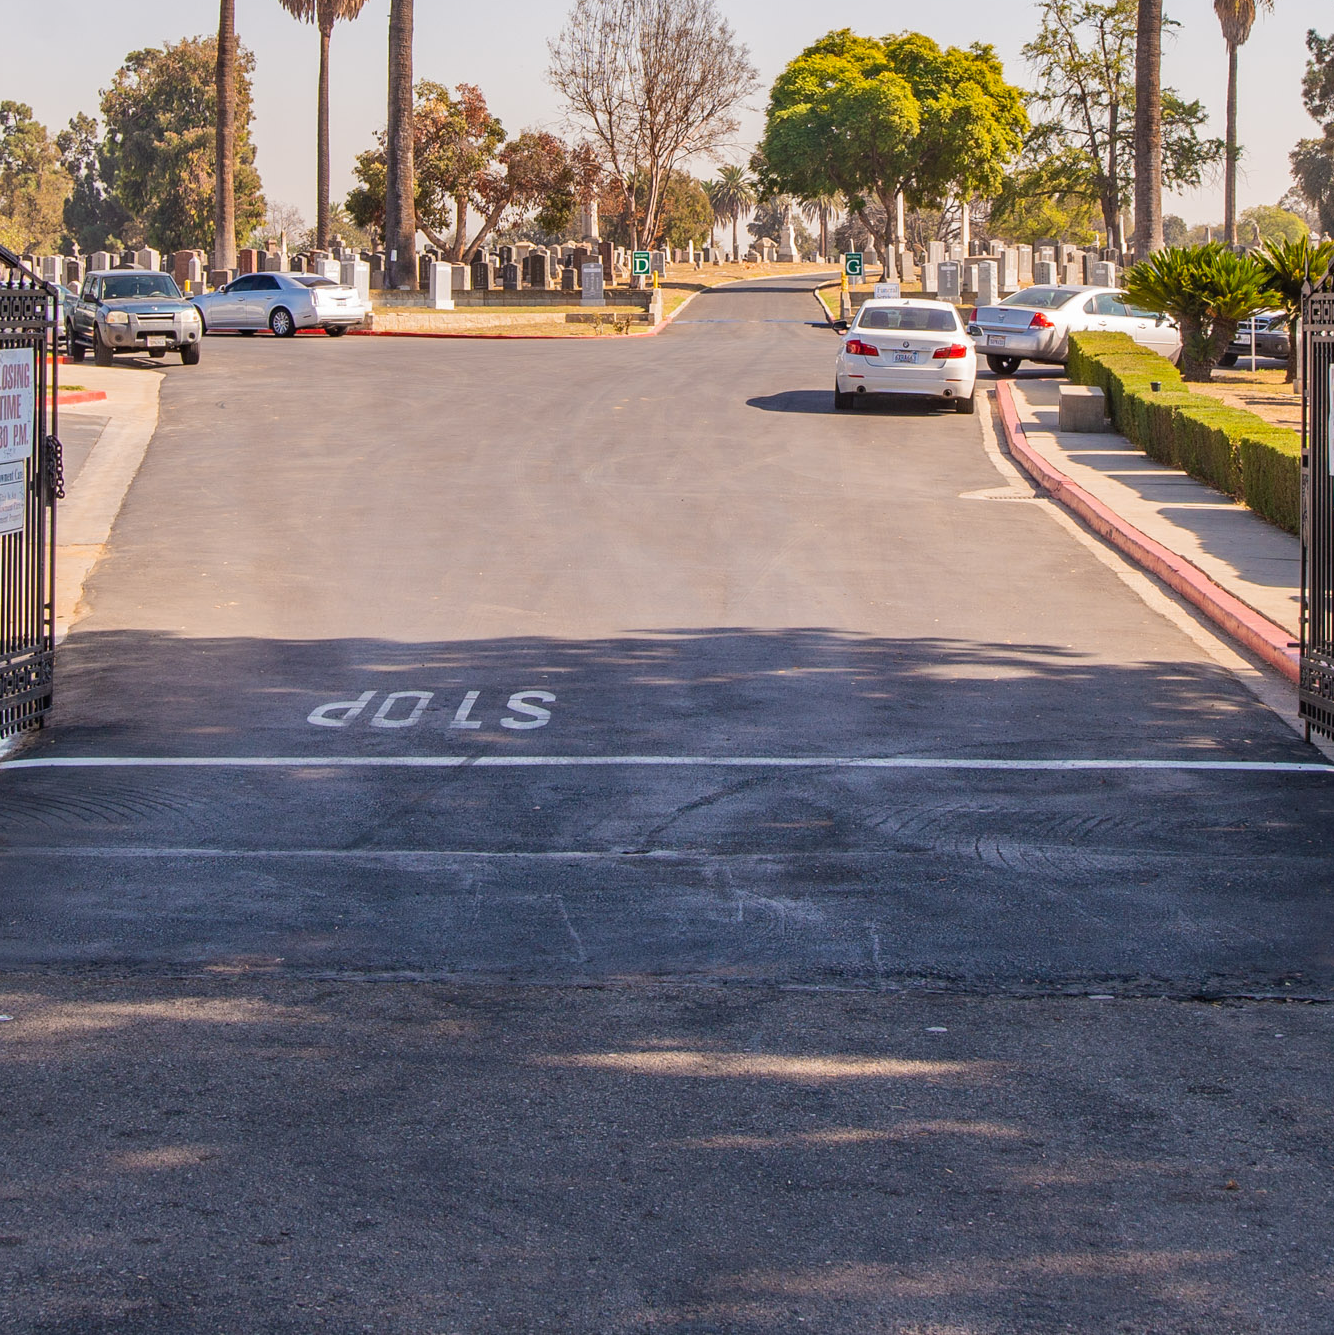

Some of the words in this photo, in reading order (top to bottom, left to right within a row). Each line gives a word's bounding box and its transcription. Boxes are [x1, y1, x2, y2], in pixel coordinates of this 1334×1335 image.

[635, 258, 649, 273] D
[846, 259, 861, 274] G
[0, 394, 22, 421] TIME
[13, 423, 29, 447] P.M.
[307, 691, 557, 730] STOP
